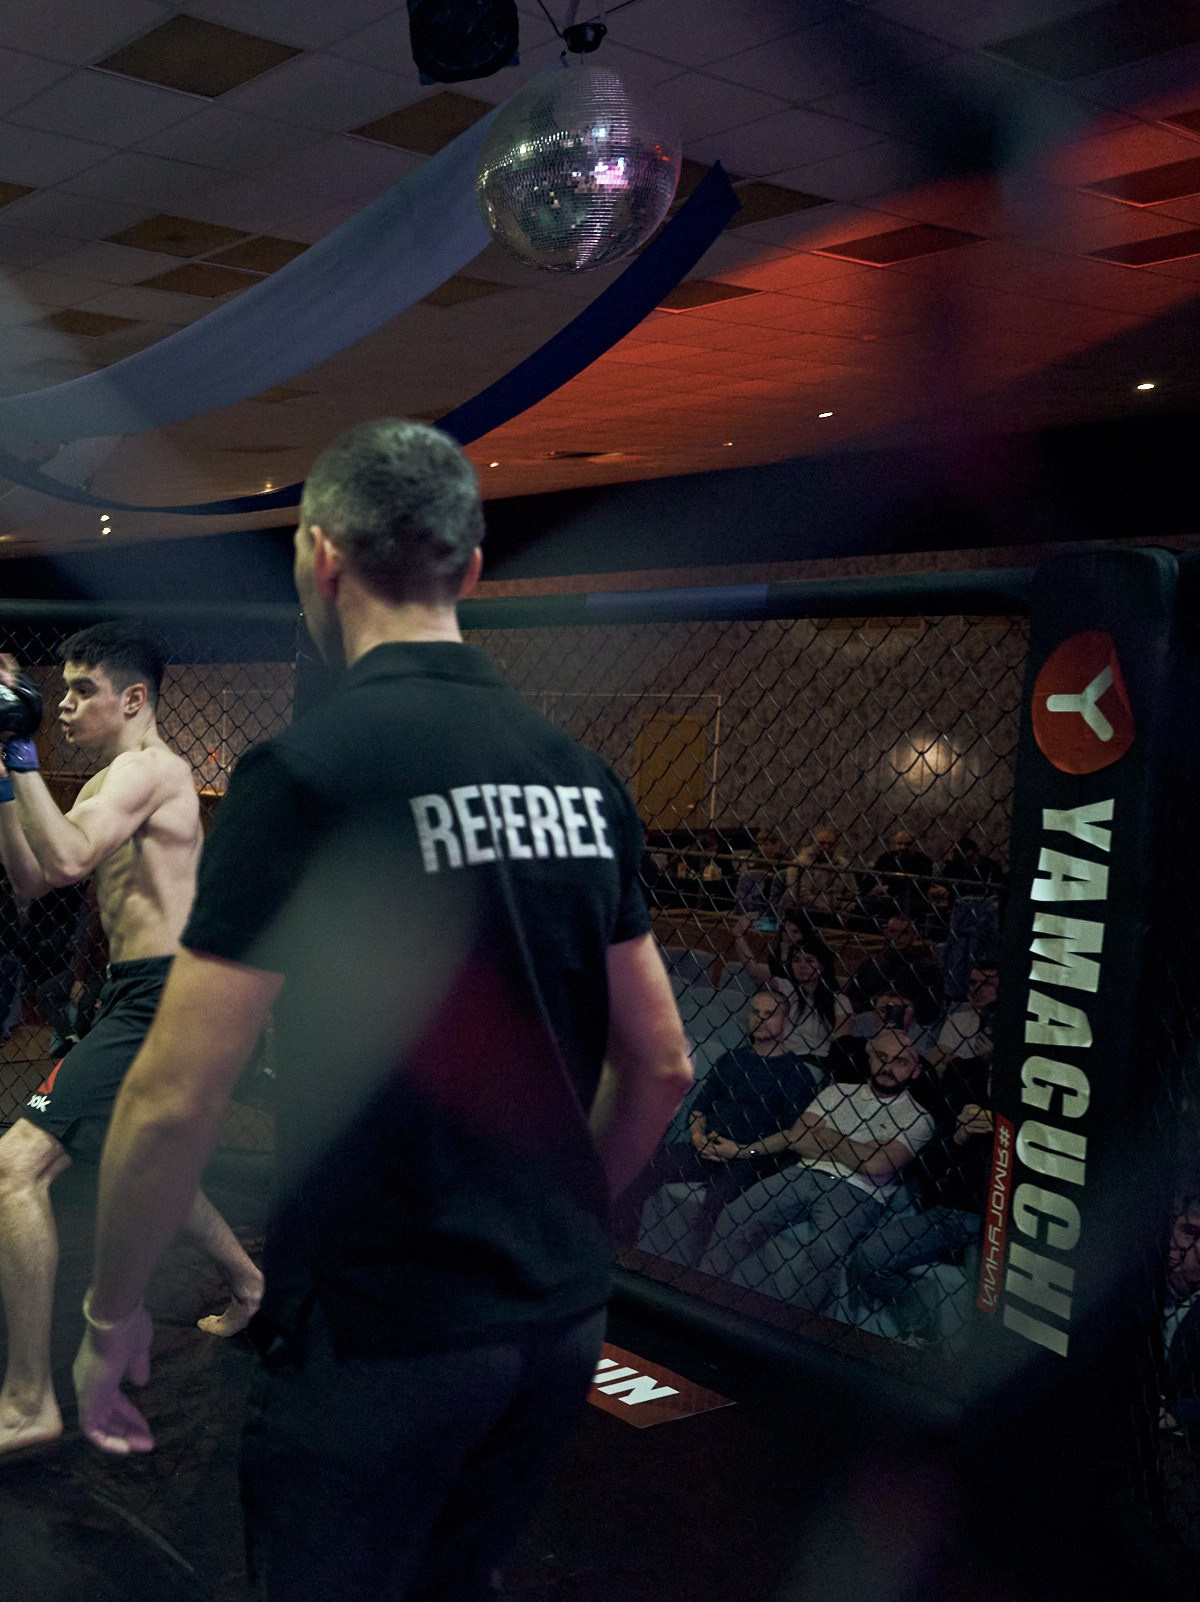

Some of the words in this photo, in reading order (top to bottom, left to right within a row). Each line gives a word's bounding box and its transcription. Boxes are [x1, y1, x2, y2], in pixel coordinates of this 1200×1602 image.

[408, 783, 615, 875] REFEREE
[1002, 798, 1116, 1358] YAMAGUCHI
[982, 1125, 1011, 1306] #ЯМОГУЧИЙ
